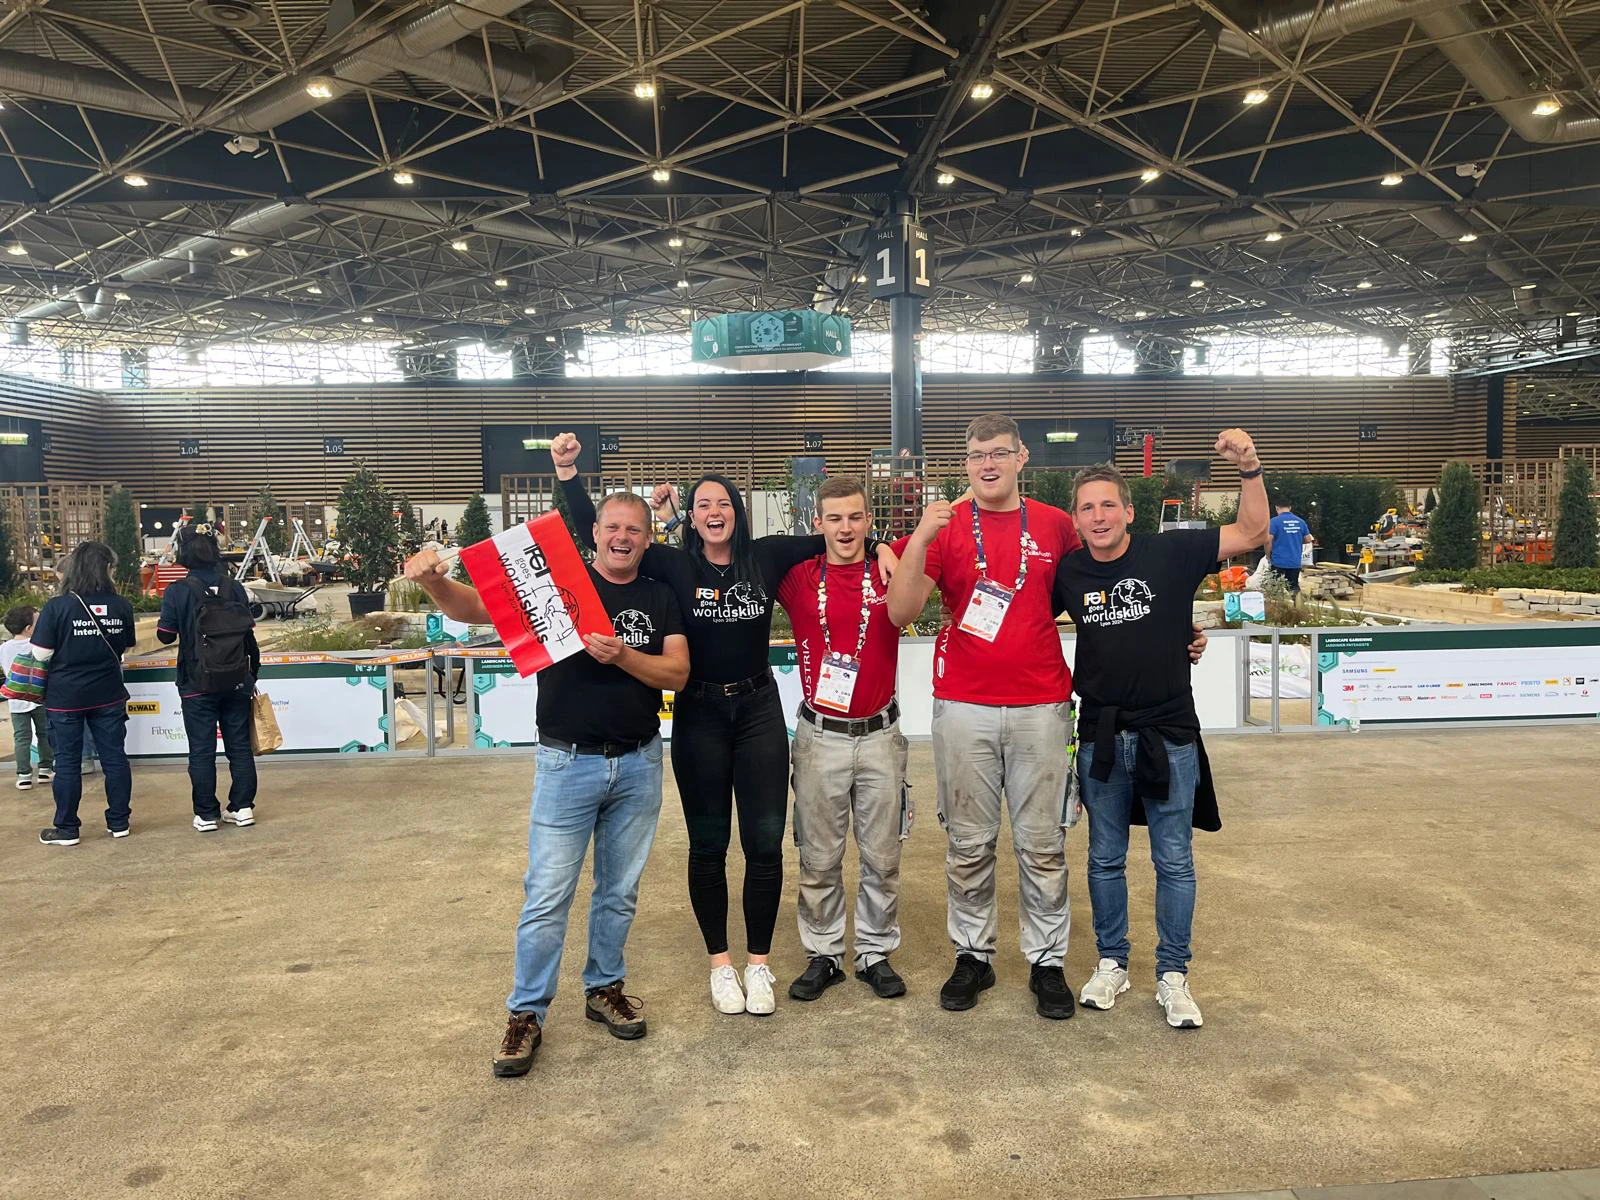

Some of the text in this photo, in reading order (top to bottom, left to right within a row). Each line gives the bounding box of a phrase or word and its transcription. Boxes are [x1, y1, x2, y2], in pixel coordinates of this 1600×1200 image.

[877, 230, 895, 240] HALL
[915, 230, 928, 241] HALL
[876, 247, 896, 287] 1
[915, 248, 930, 287] 1
[825, 329, 838, 339] HALL
[602, 443, 618, 451] 1.06
[806, 440, 822, 448] 1.07
[181, 446, 199, 455] 1.04
[325, 445, 343, 454] 1.05
[515, 557, 531, 579] goes
[498, 552, 548, 645] worldskills
[700, 600, 717, 608] goes
[1088, 604, 1105, 613] goes
[693, 603, 765, 618] worldskills
[1082, 603, 1151, 624] worldskills
[100, 618, 123, 626] Skills
[801, 637, 814, 708] AUSTRIA
